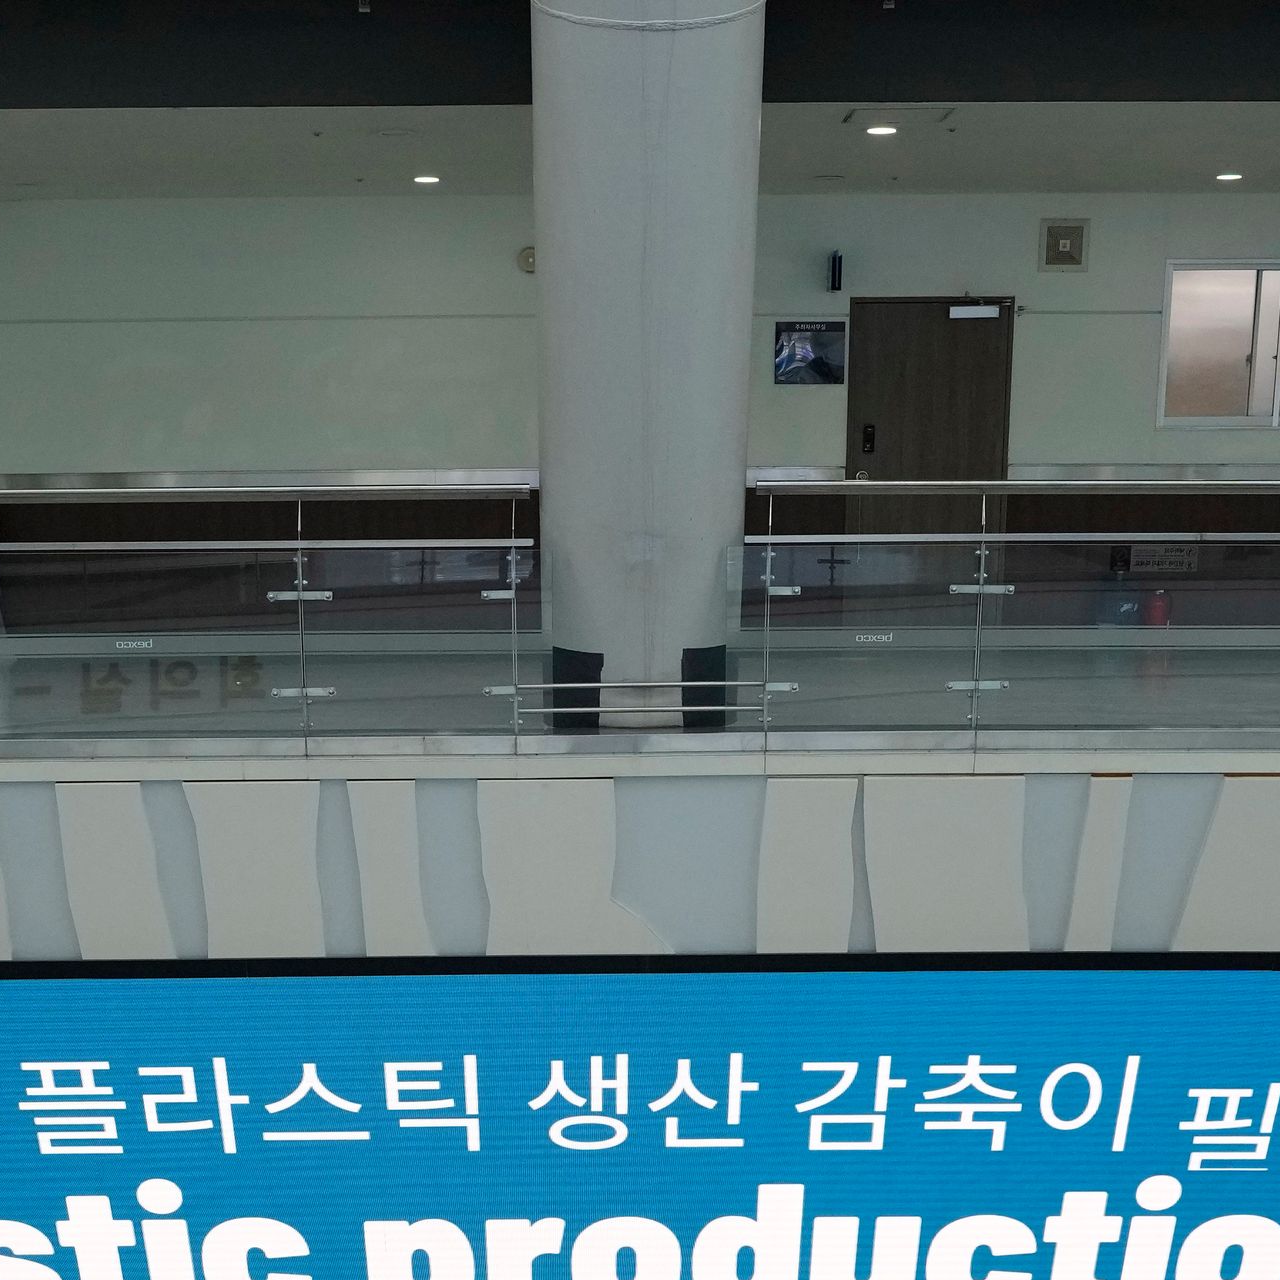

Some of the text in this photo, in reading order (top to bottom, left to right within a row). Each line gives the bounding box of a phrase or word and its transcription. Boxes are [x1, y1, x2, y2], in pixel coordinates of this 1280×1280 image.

[19, 1054, 480, 1155] 플라스틱
[528, 1053, 759, 1150] 생산
[796, 1055, 1140, 1152] 감축이
